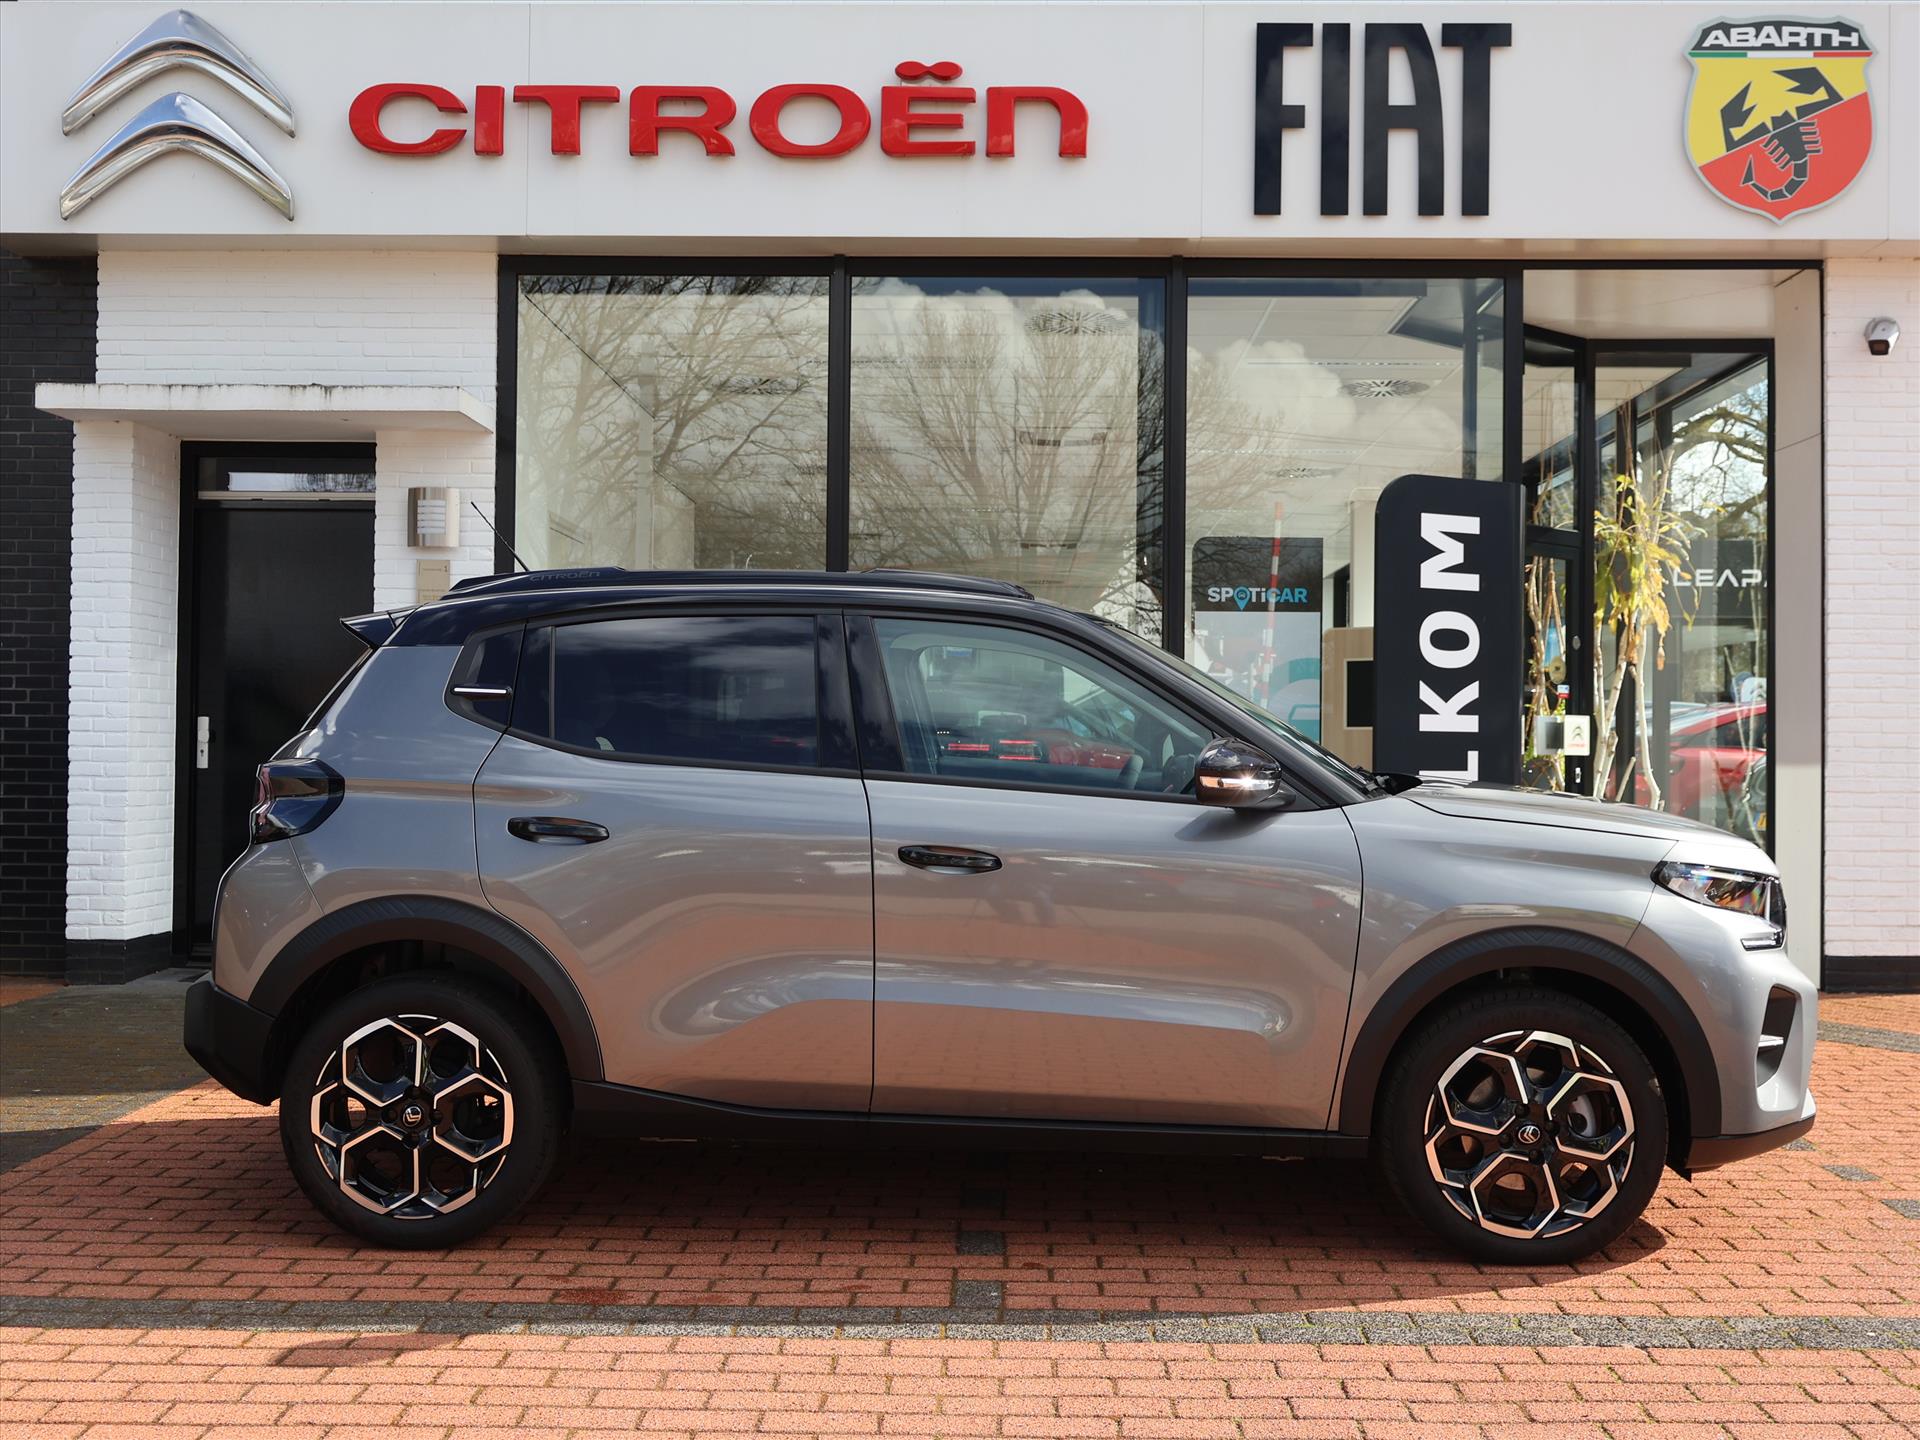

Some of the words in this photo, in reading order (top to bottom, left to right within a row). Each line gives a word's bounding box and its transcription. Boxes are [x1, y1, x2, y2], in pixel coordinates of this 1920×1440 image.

[1702, 26, 1859, 47] ABARTH
[349, 61, 1089, 157] CITROËN
[1254, 23, 1512, 215] FIAT
[1673, 568, 1768, 588] LEAP
